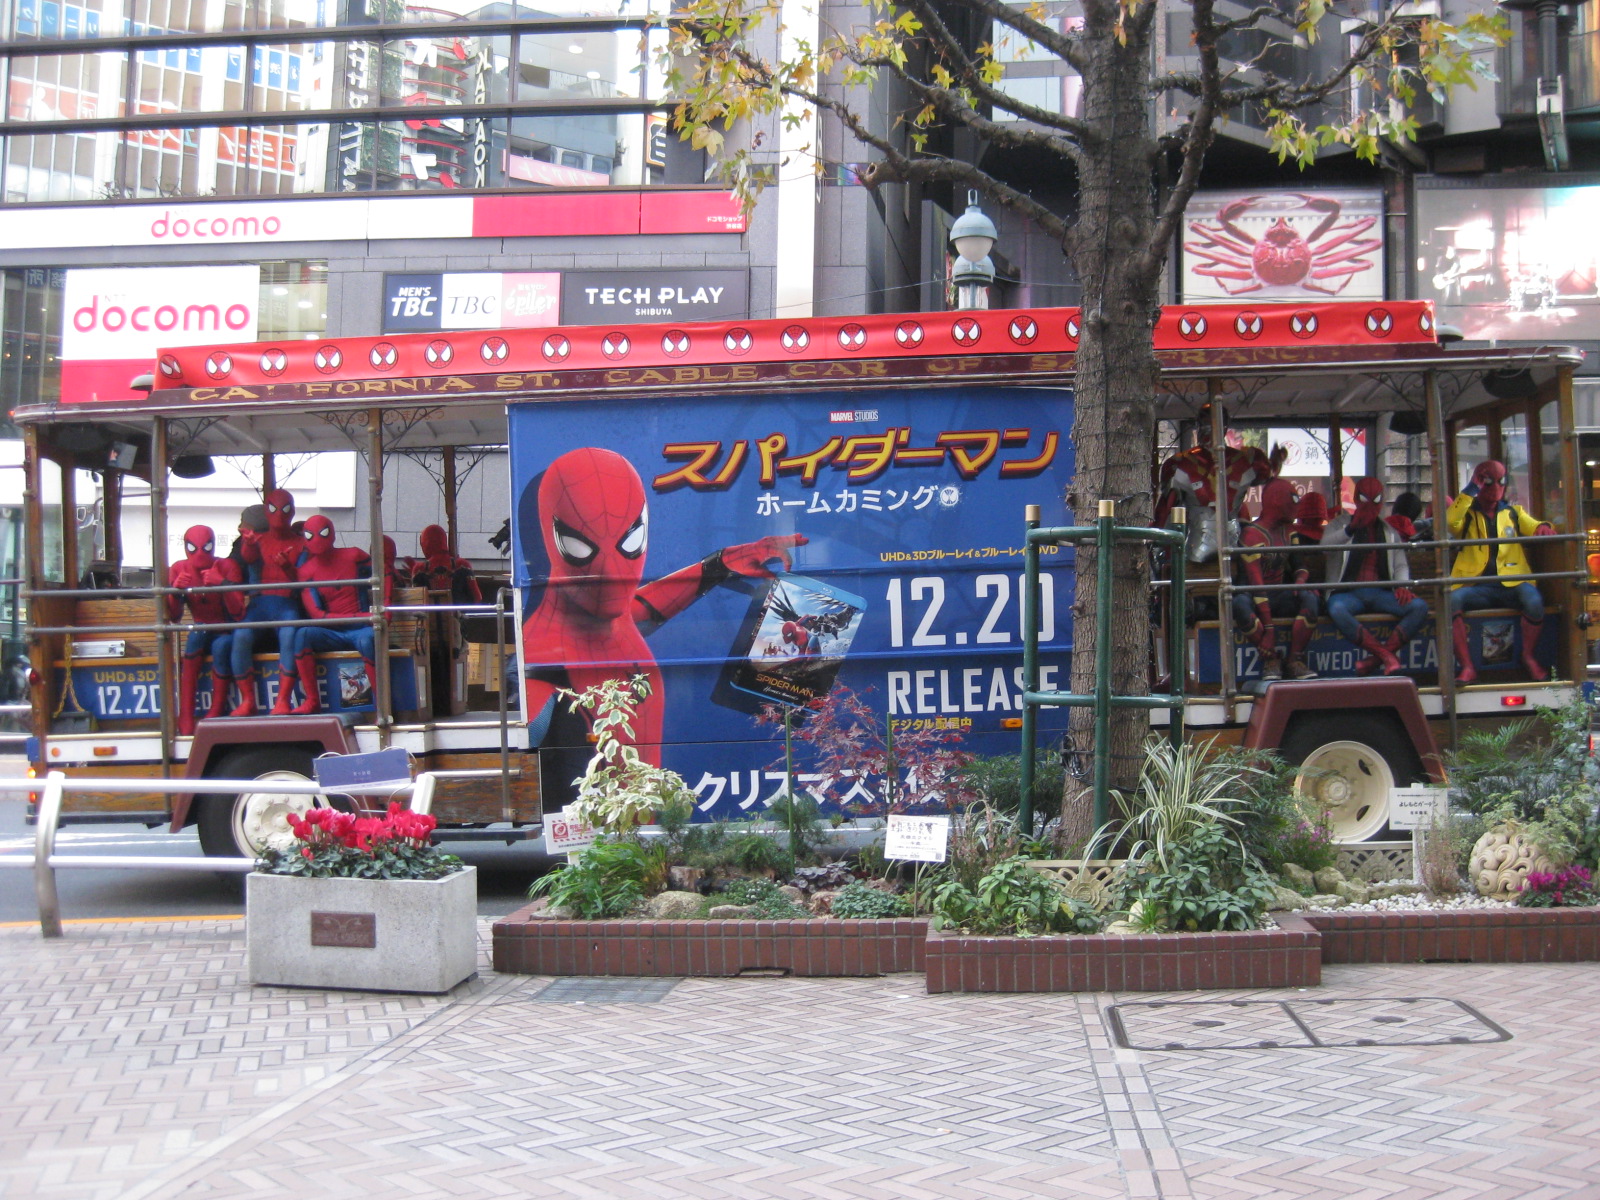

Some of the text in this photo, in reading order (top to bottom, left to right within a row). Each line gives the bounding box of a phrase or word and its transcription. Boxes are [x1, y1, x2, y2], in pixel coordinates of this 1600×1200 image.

[151, 211, 281, 238] docomo
[398, 286, 432, 297] MEN'S
[585, 287, 724, 304] TECH PLAY
[73, 295, 250, 333] docomo
[391, 296, 438, 317] TBC
[448, 295, 496, 314] TBC
[635, 308, 673, 316] SHIBUYA
[190, 376, 476, 401] CAFORNIA
[495, 373, 561, 389] ST.
[603, 364, 758, 384] CABLE
[788, 360, 888, 378] CAR
[926, 356, 983, 374] OF
[830, 409, 879, 422] MARVEL STUDIOS
[652, 426, 1061, 493] スパイダーマン
[756, 485, 938, 517] ホームカミング
[885, 572, 1055, 648] 12.20
